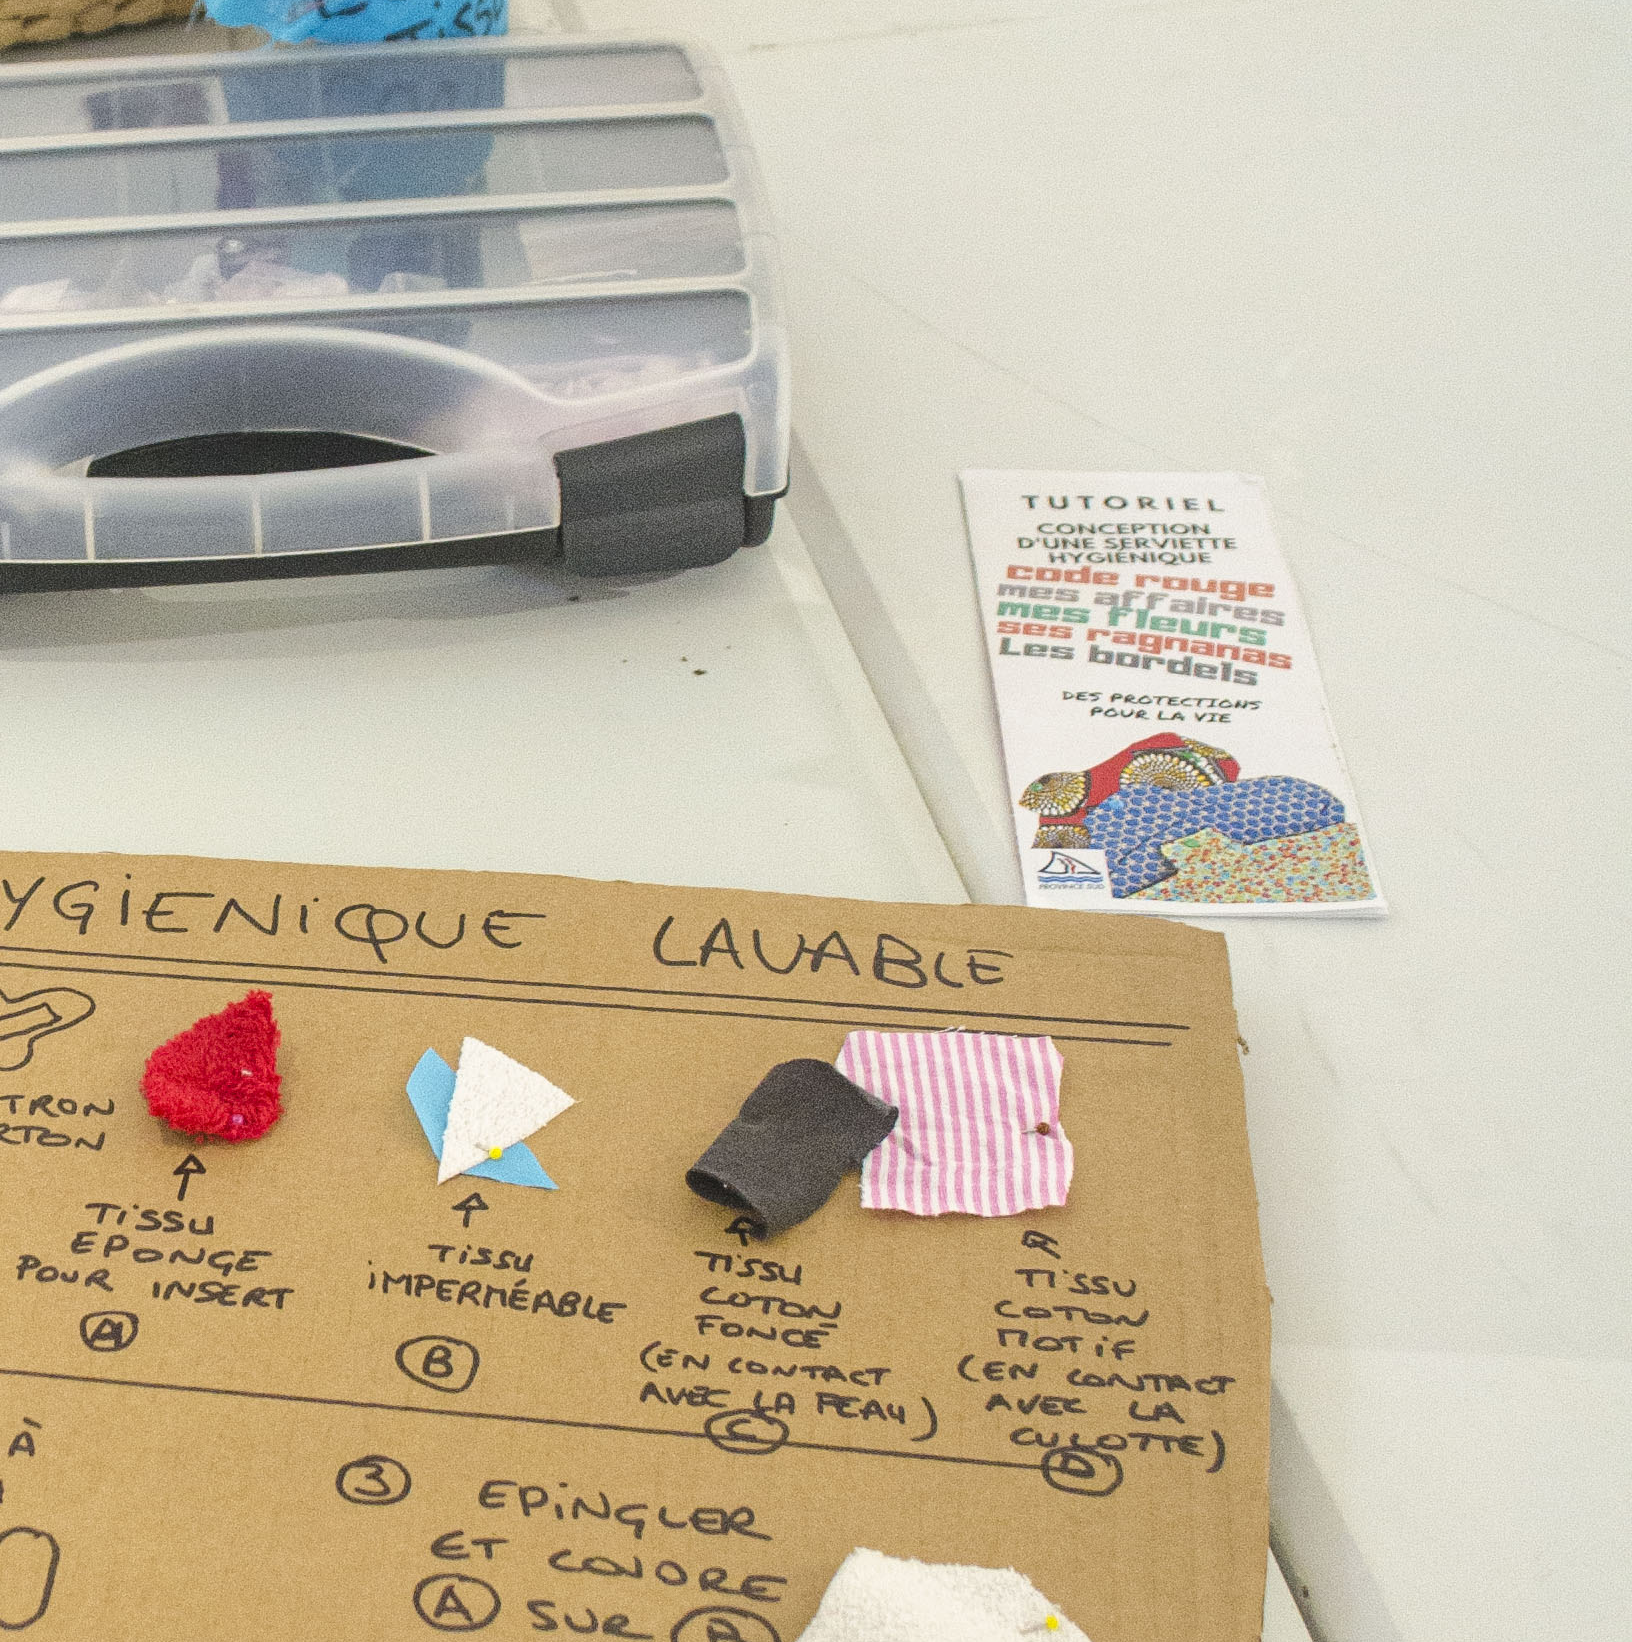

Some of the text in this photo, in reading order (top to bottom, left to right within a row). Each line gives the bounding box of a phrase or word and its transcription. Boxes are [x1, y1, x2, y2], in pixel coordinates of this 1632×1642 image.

[1021, 495, 1226, 513] TUTORIEL
[1017, 537, 1239, 551] D'UNE SERVIETTE
[1037, 522, 1211, 535] CONCEPTION
[1006, 564, 1276, 602] code rouge
[996, 583, 1286, 627] mes affaires
[996, 600, 1268, 647] mes fleurs
[996, 620, 1293, 670] ses ragnanas
[999, 636, 1258, 687] Les bordels
[1062, 690, 1263, 711] DES PROTECTIONS
[1090, 706, 1232, 723] POUR LA VIE
[653, 916, 1013, 989] LAVABLE
[71, 1231, 272, 1277] EPONGE
[17, 1255, 294, 1309] POUR INSERT
[700, 1286, 842, 1319] COTON
[994, 1300, 1149, 1327] COTON
[640, 1341, 891, 1387] (EN CONTACT
[957, 1354, 1235, 1396] (EN CONTACT
[640, 1382, 730, 1408] AVEC
[752, 1387, 796, 1416] LA
[985, 1393, 1185, 1424] AVEC LA
[430, 1530, 508, 1560] ET
[527, 1600, 654, 1640] SUR
